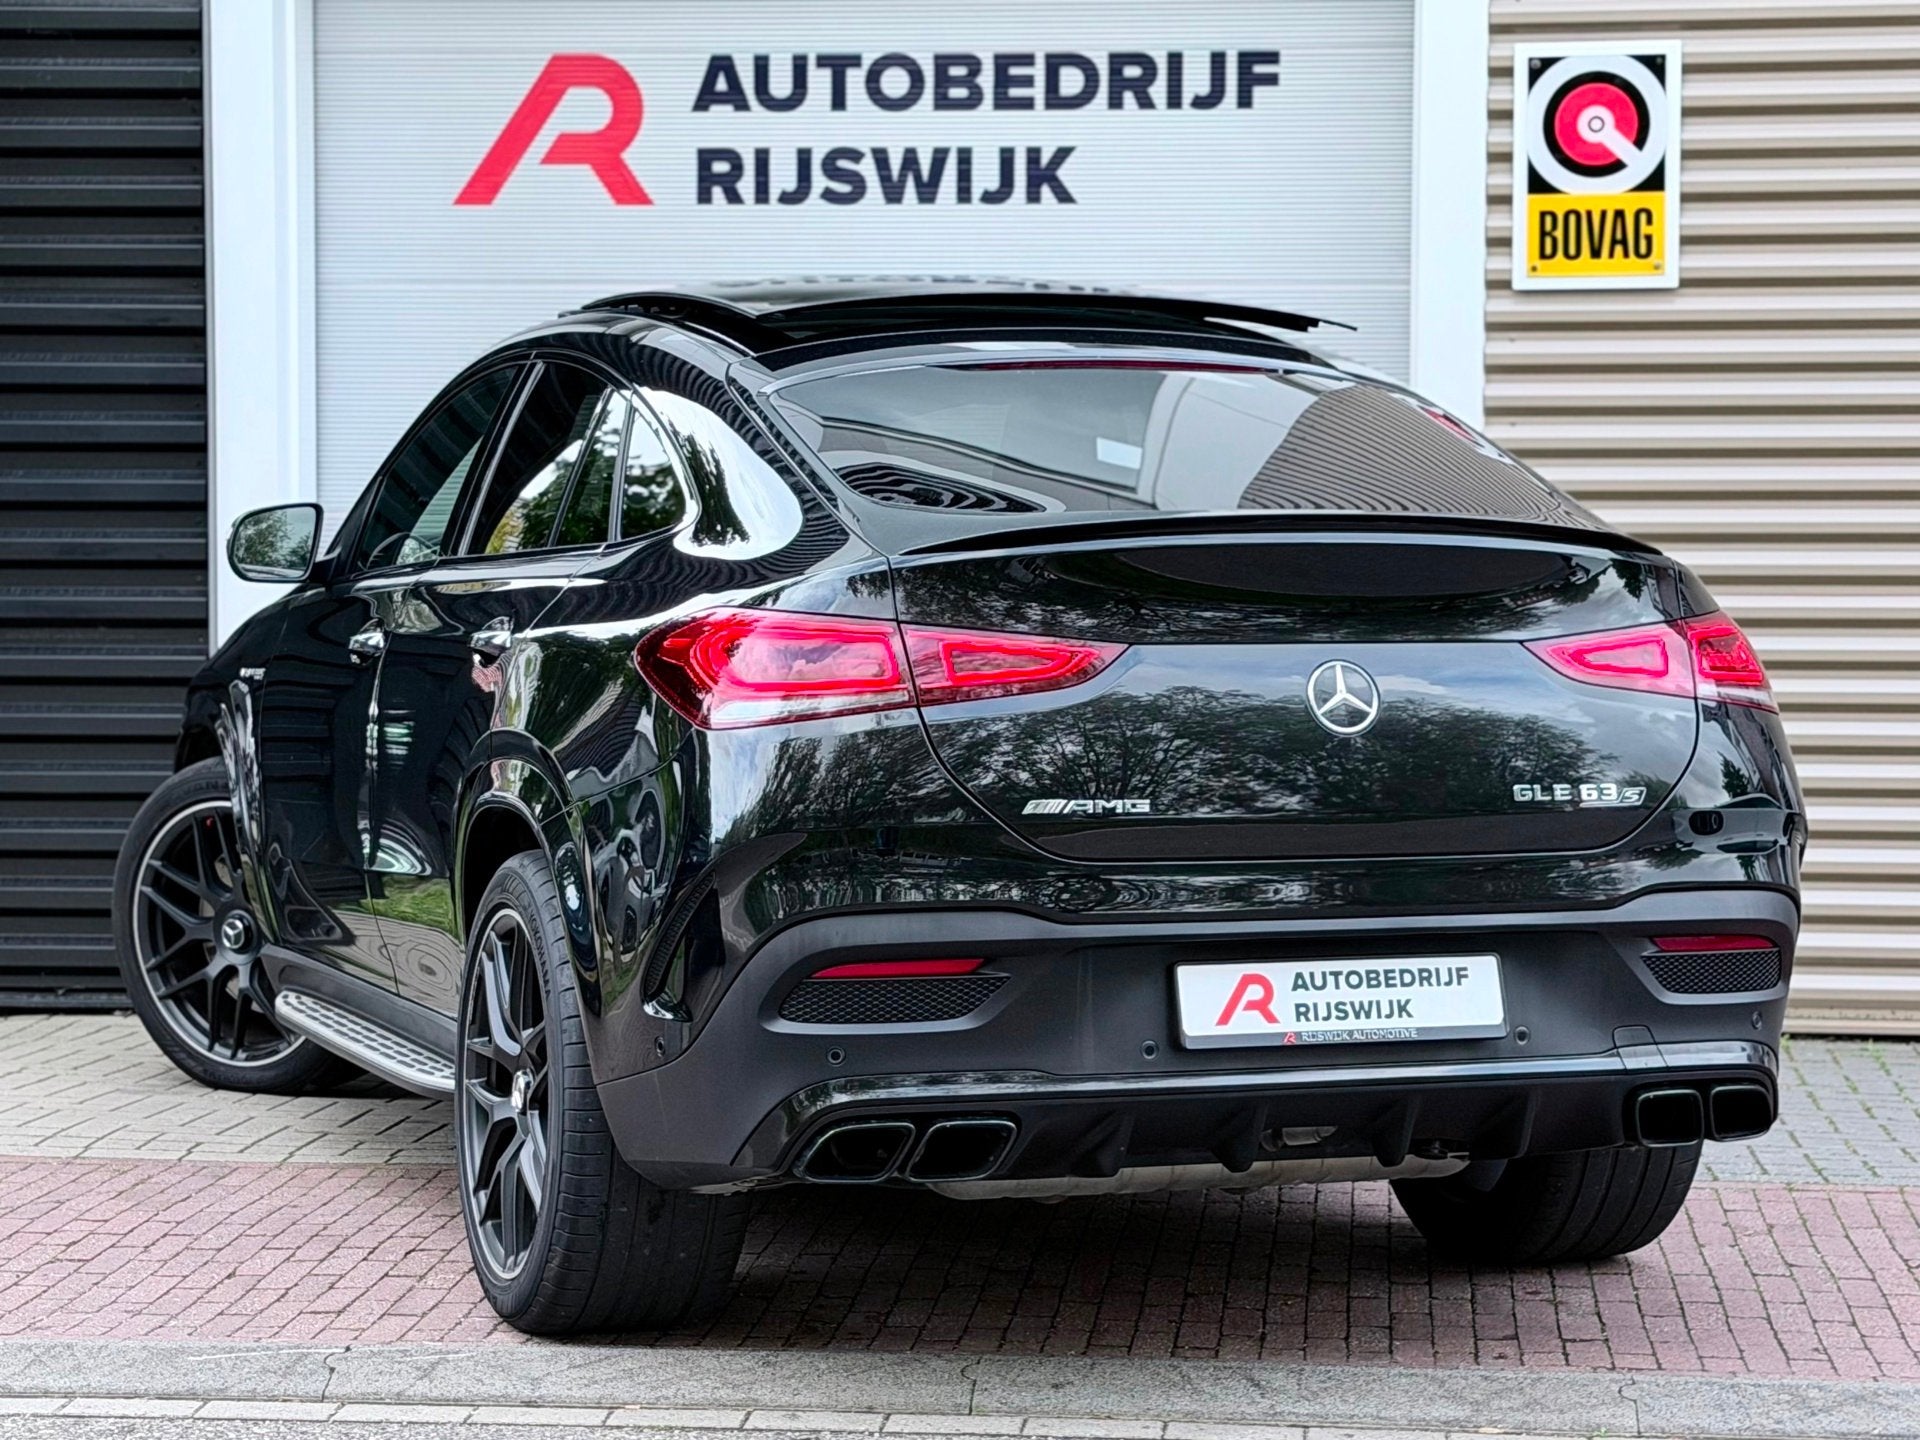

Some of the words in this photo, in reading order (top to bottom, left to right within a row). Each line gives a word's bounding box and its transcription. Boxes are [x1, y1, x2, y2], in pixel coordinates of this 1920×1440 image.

[692, 51, 1280, 112] AUTOBEDRIJF
[696, 146, 1078, 206] RIJSWIJK
[1539, 208, 1653, 260] BOVAG
[1512, 784, 1573, 802] GLE
[1291, 967, 1469, 991] AUTOBEDRIJF
[1294, 998, 1414, 1023] RIJSWIJK
[1301, 1030, 1350, 1042] RIJSWIJK
[1351, 1027, 1419, 1041] AUTOMOTIVE
